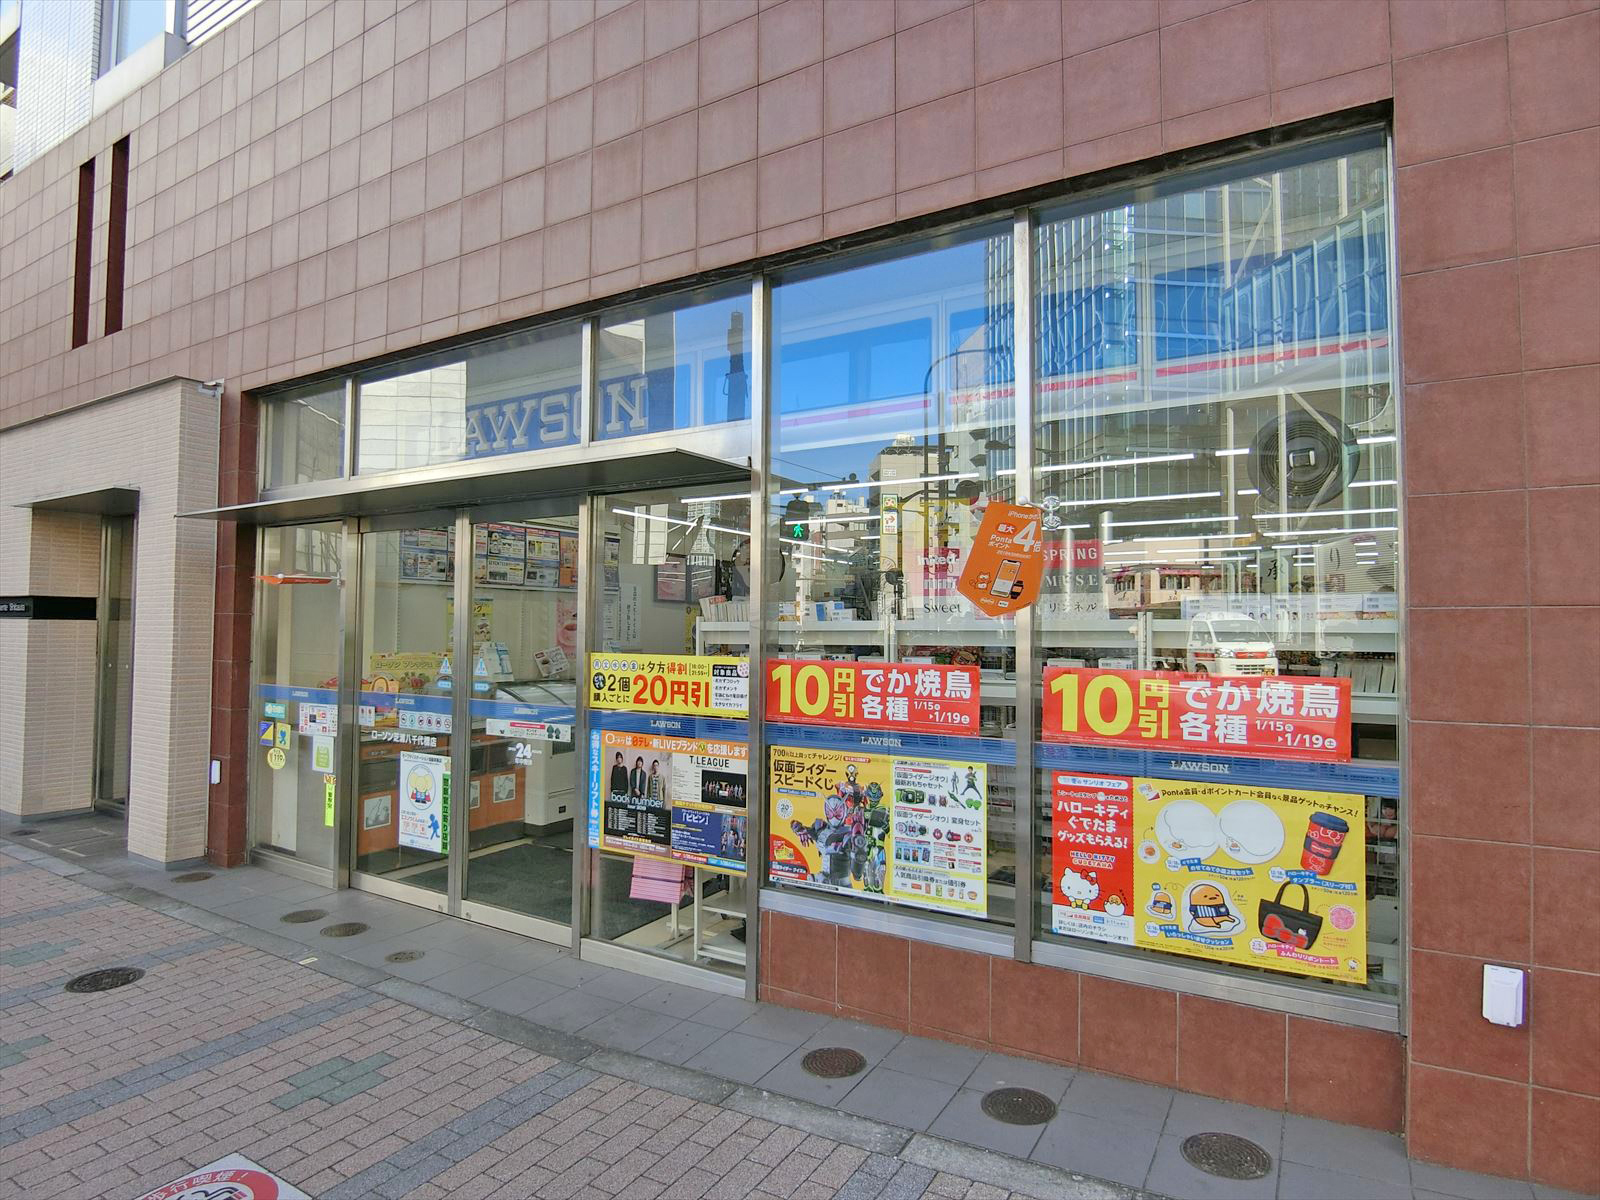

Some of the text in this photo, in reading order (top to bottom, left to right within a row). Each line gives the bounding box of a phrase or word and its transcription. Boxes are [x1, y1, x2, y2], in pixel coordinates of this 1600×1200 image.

[997, 524, 1015, 533] 最大
[988, 541, 1010, 550] ポイント
[990, 534, 1012, 544] Ponta
[1045, 574, 1098, 588] MUSE
[713, 668, 738, 677] 対象商品
[633, 674, 709, 709] 20円引
[771, 664, 830, 717] 10
[861, 668, 972, 700] でか焼鳥
[593, 692, 630, 704] 購入ごとに
[833, 668, 855, 719] 円引
[1178, 679, 1340, 719] でか焼鳥
[861, 694, 909, 722] 各種
[1049, 673, 1133, 737] 10
[1138, 679, 1170, 740] 円引
[650, 719, 682, 730] LAWSON
[1179, 711, 1249, 745] 各種
[514, 742, 533, 760] 24
[860, 736, 902, 748] LAWSON
[689, 755, 730, 769] T.LEAGUE
[773, 759, 838, 776] 仮面ライダー
[1169, 760, 1231, 775] LAWSON
[774, 773, 835, 791] スピードくじ
[895, 779, 944, 790] 最新おもちゃセット
[610, 791, 631, 804] back
[631, 794, 664, 809] number
[1057, 800, 1129, 819] ハローキティ
[951, 817, 982, 826] 変身セット
[1068, 815, 1117, 833] ぐでたま
[1057, 829, 1129, 849] グッズもらえる!
[1093, 852, 1116, 864] KITTY
